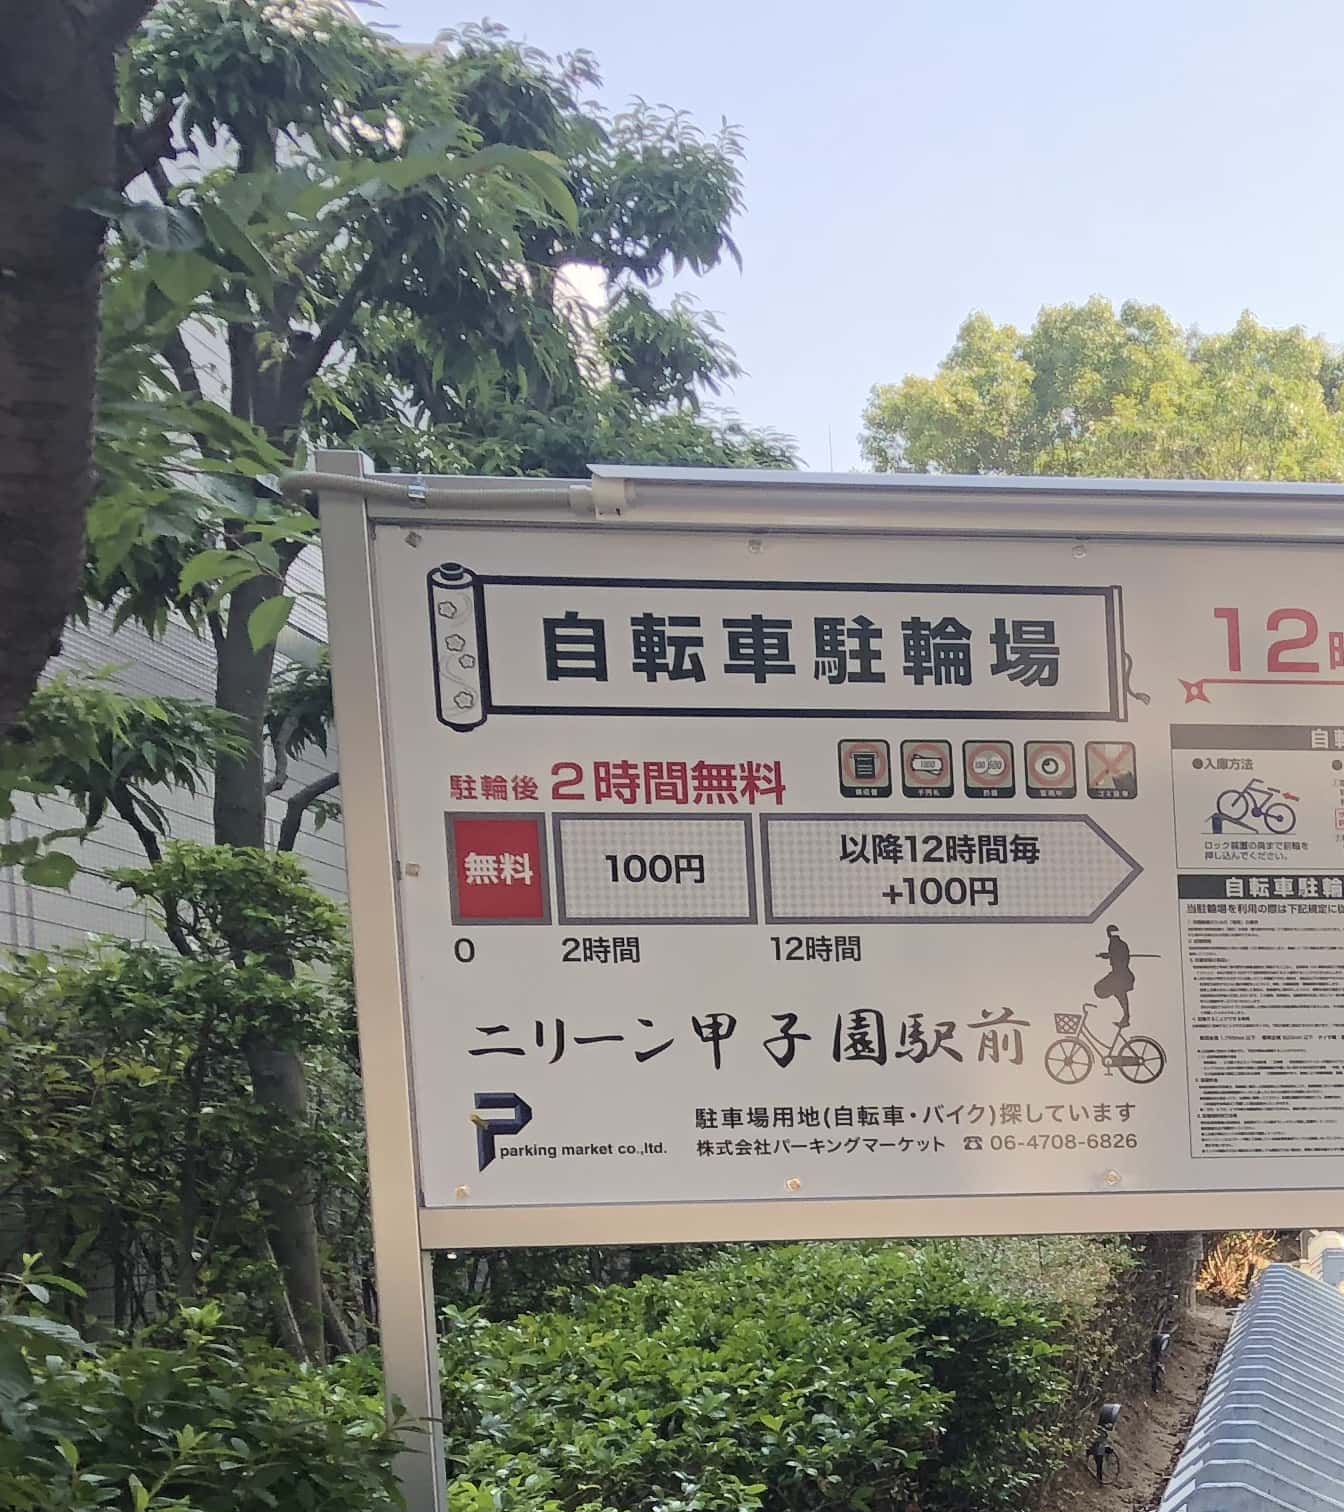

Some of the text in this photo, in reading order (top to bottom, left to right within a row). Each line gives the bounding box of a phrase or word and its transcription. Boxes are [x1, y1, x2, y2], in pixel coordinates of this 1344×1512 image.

[540, 609, 1061, 688] 自転車駐輪場
[1204, 758, 1253, 770] 入庫方法
[448, 760, 787, 806] 駐輪後 2時間無料
[838, 833, 1041, 865] 以降12時間毎
[463, 852, 534, 885] 無料
[606, 854, 706, 884] 100円
[881, 876, 1000, 908] +100円
[454, 939, 476, 963] 0
[561, 936, 641, 964] 2時間
[770, 935, 863, 963] 12時間
[467, 1007, 1032, 1070] ニリーン甲子園駅前
[499, 1142, 557, 1160] parking
[561, 1142, 612, 1159] market
[696, 1132, 1139, 1157] 株式会社パーキングマーケット 06-4708-6826
